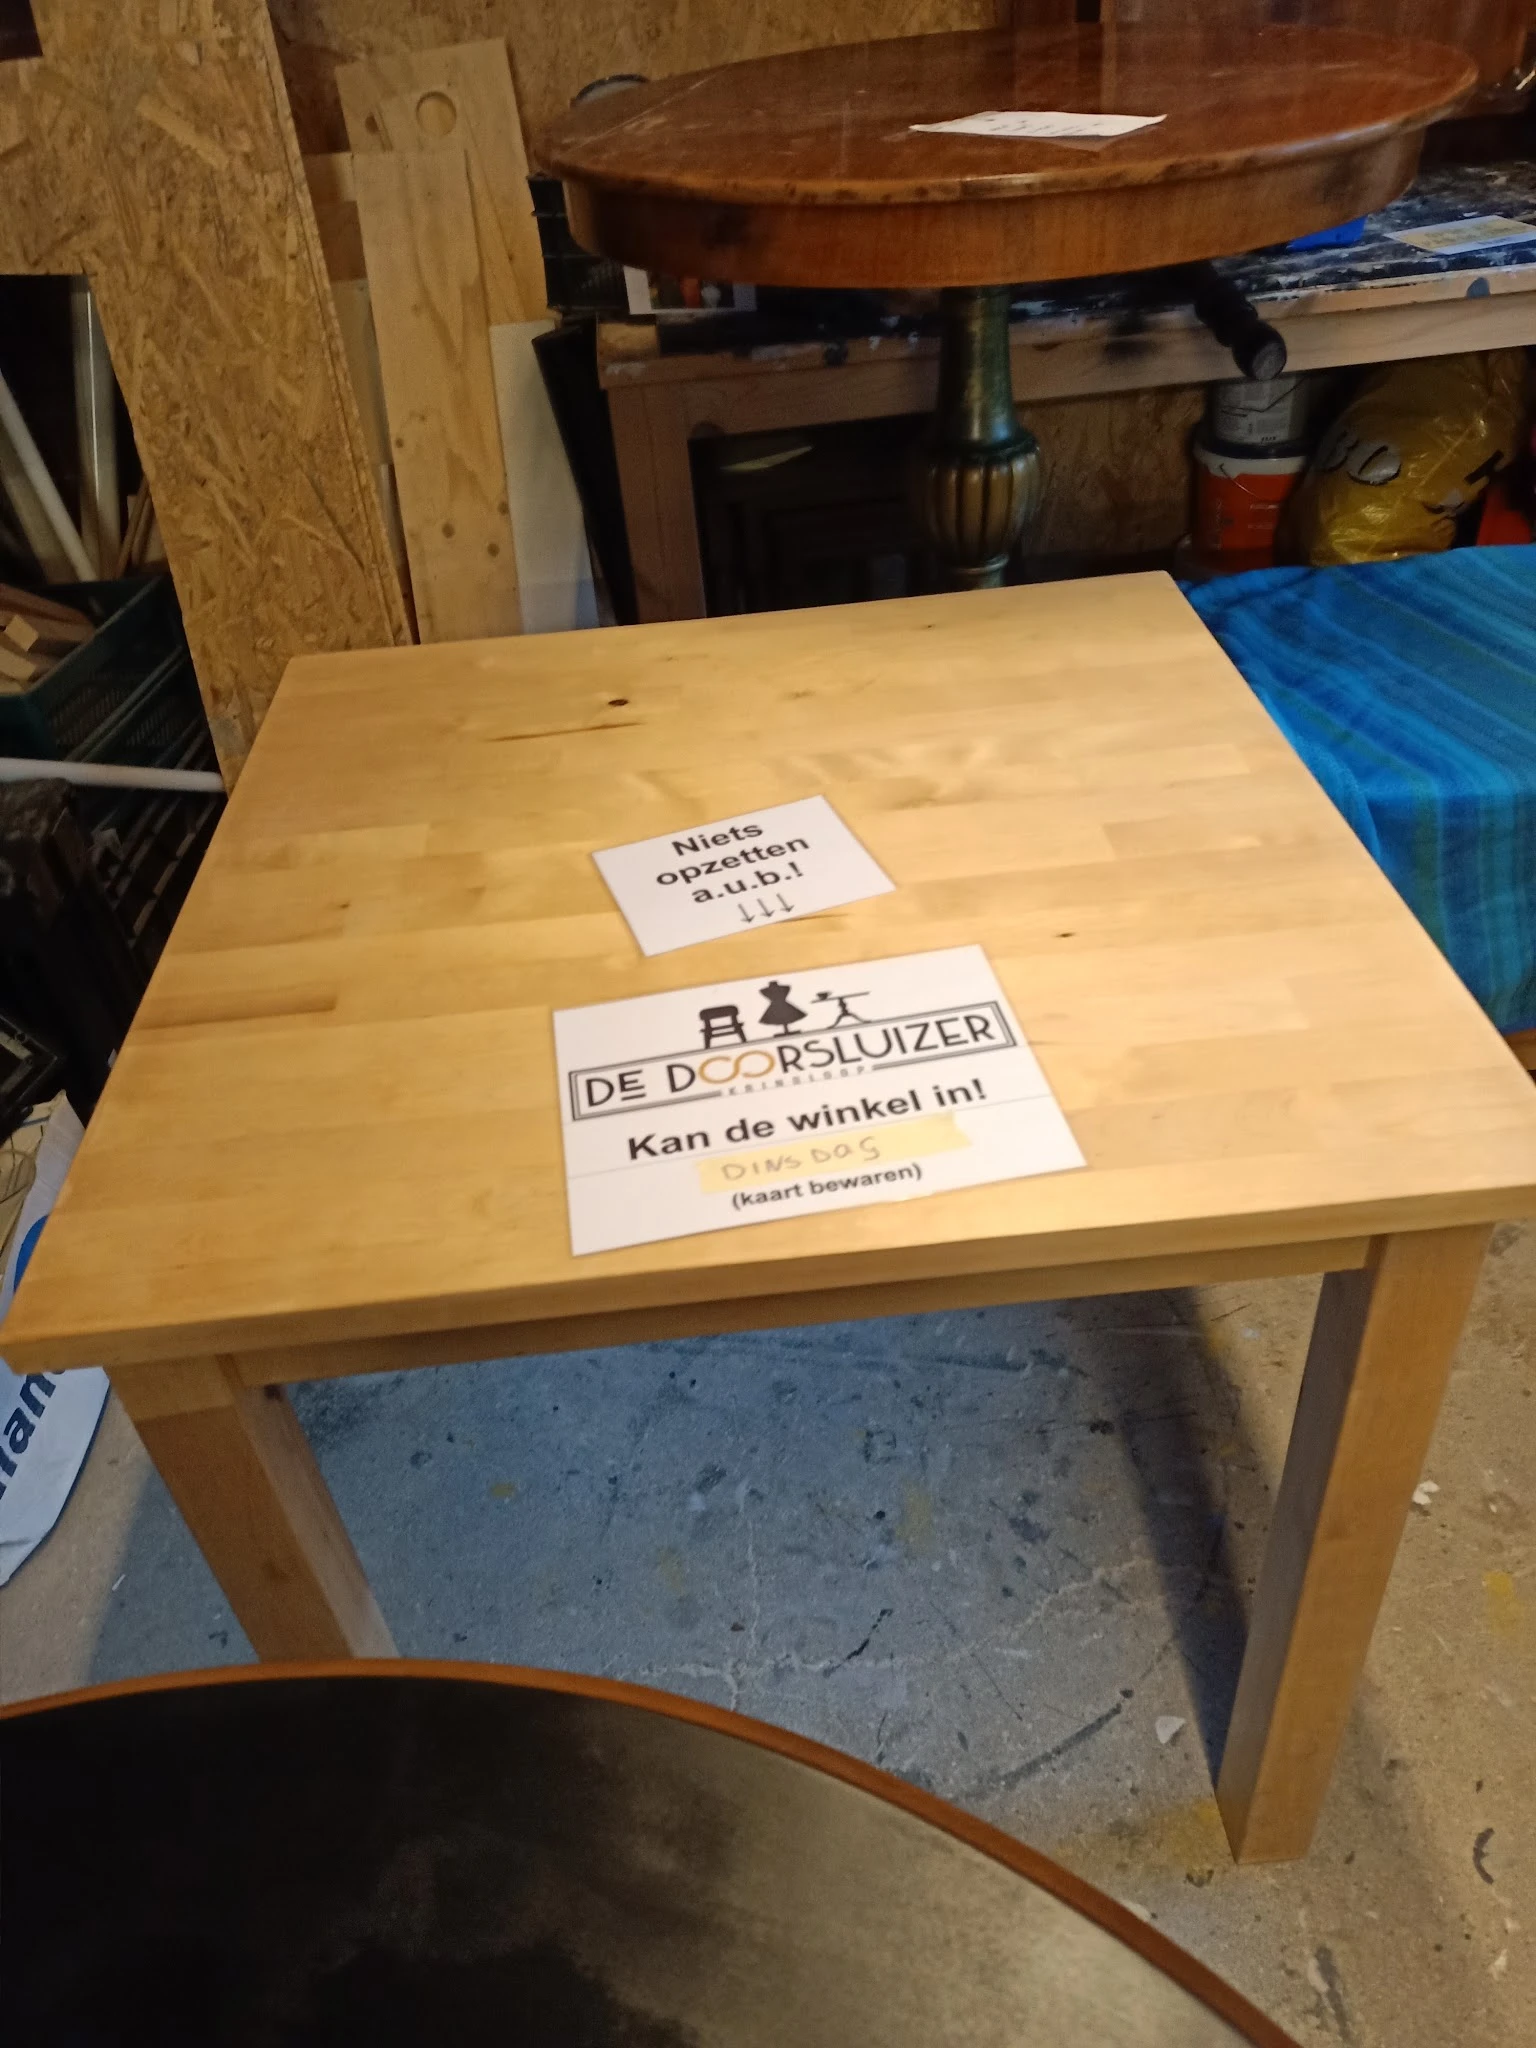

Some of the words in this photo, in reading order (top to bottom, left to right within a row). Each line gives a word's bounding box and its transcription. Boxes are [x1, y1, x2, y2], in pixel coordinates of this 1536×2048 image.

[656, 838, 810, 886] opzetten
[672, 824, 763, 856] Niets
[691, 862, 804, 903] a.u.b.!
[585, 1070, 646, 1107] DE
[667, 1014, 994, 1093] DOORSLUIZER
[628, 1128, 711, 1160] Kan
[726, 1117, 776, 1141] de
[788, 1089, 923, 1130] winkel
[933, 1077, 987, 1108] in!
[732, 1182, 803, 1211] (kaart
[808, 1162, 924, 1196] bewaren)
